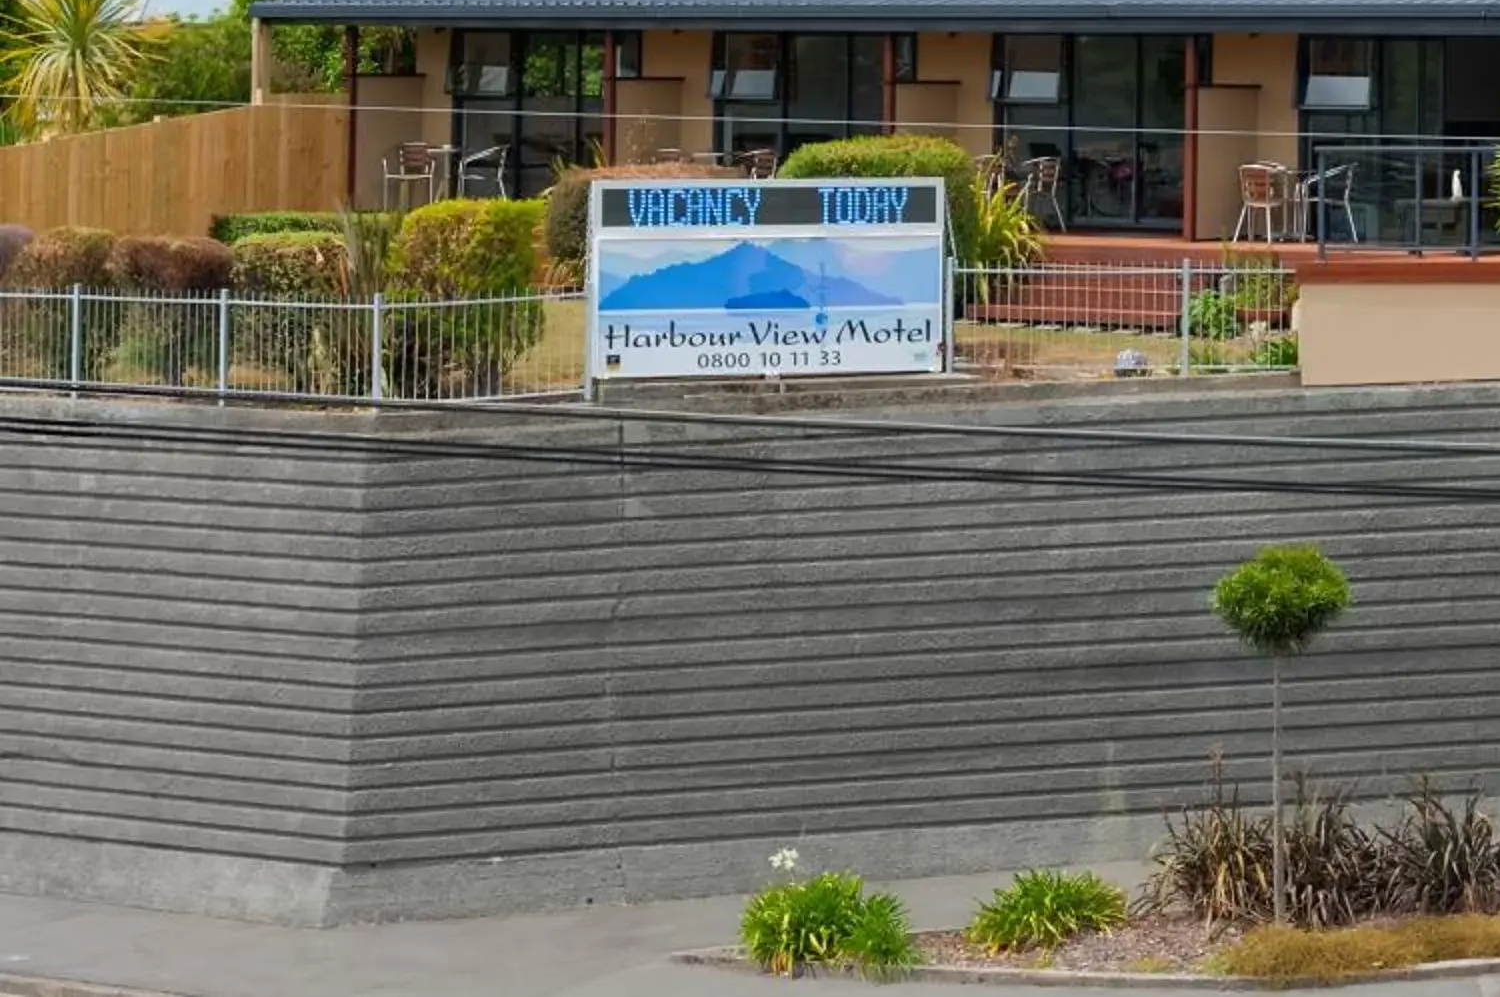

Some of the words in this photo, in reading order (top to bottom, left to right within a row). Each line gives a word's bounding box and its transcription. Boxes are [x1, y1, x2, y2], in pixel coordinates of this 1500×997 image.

[628, 187, 761, 227] VACANCY
[817, 186, 909, 225] TODAY
[604, 320, 744, 350] Harbour
[748, 320, 828, 347] View
[834, 318, 932, 345] Motel
[697, 352, 751, 369] 0800
[760, 351, 782, 368] 10
[790, 351, 811, 367] 11
[820, 349, 842, 367] 33
